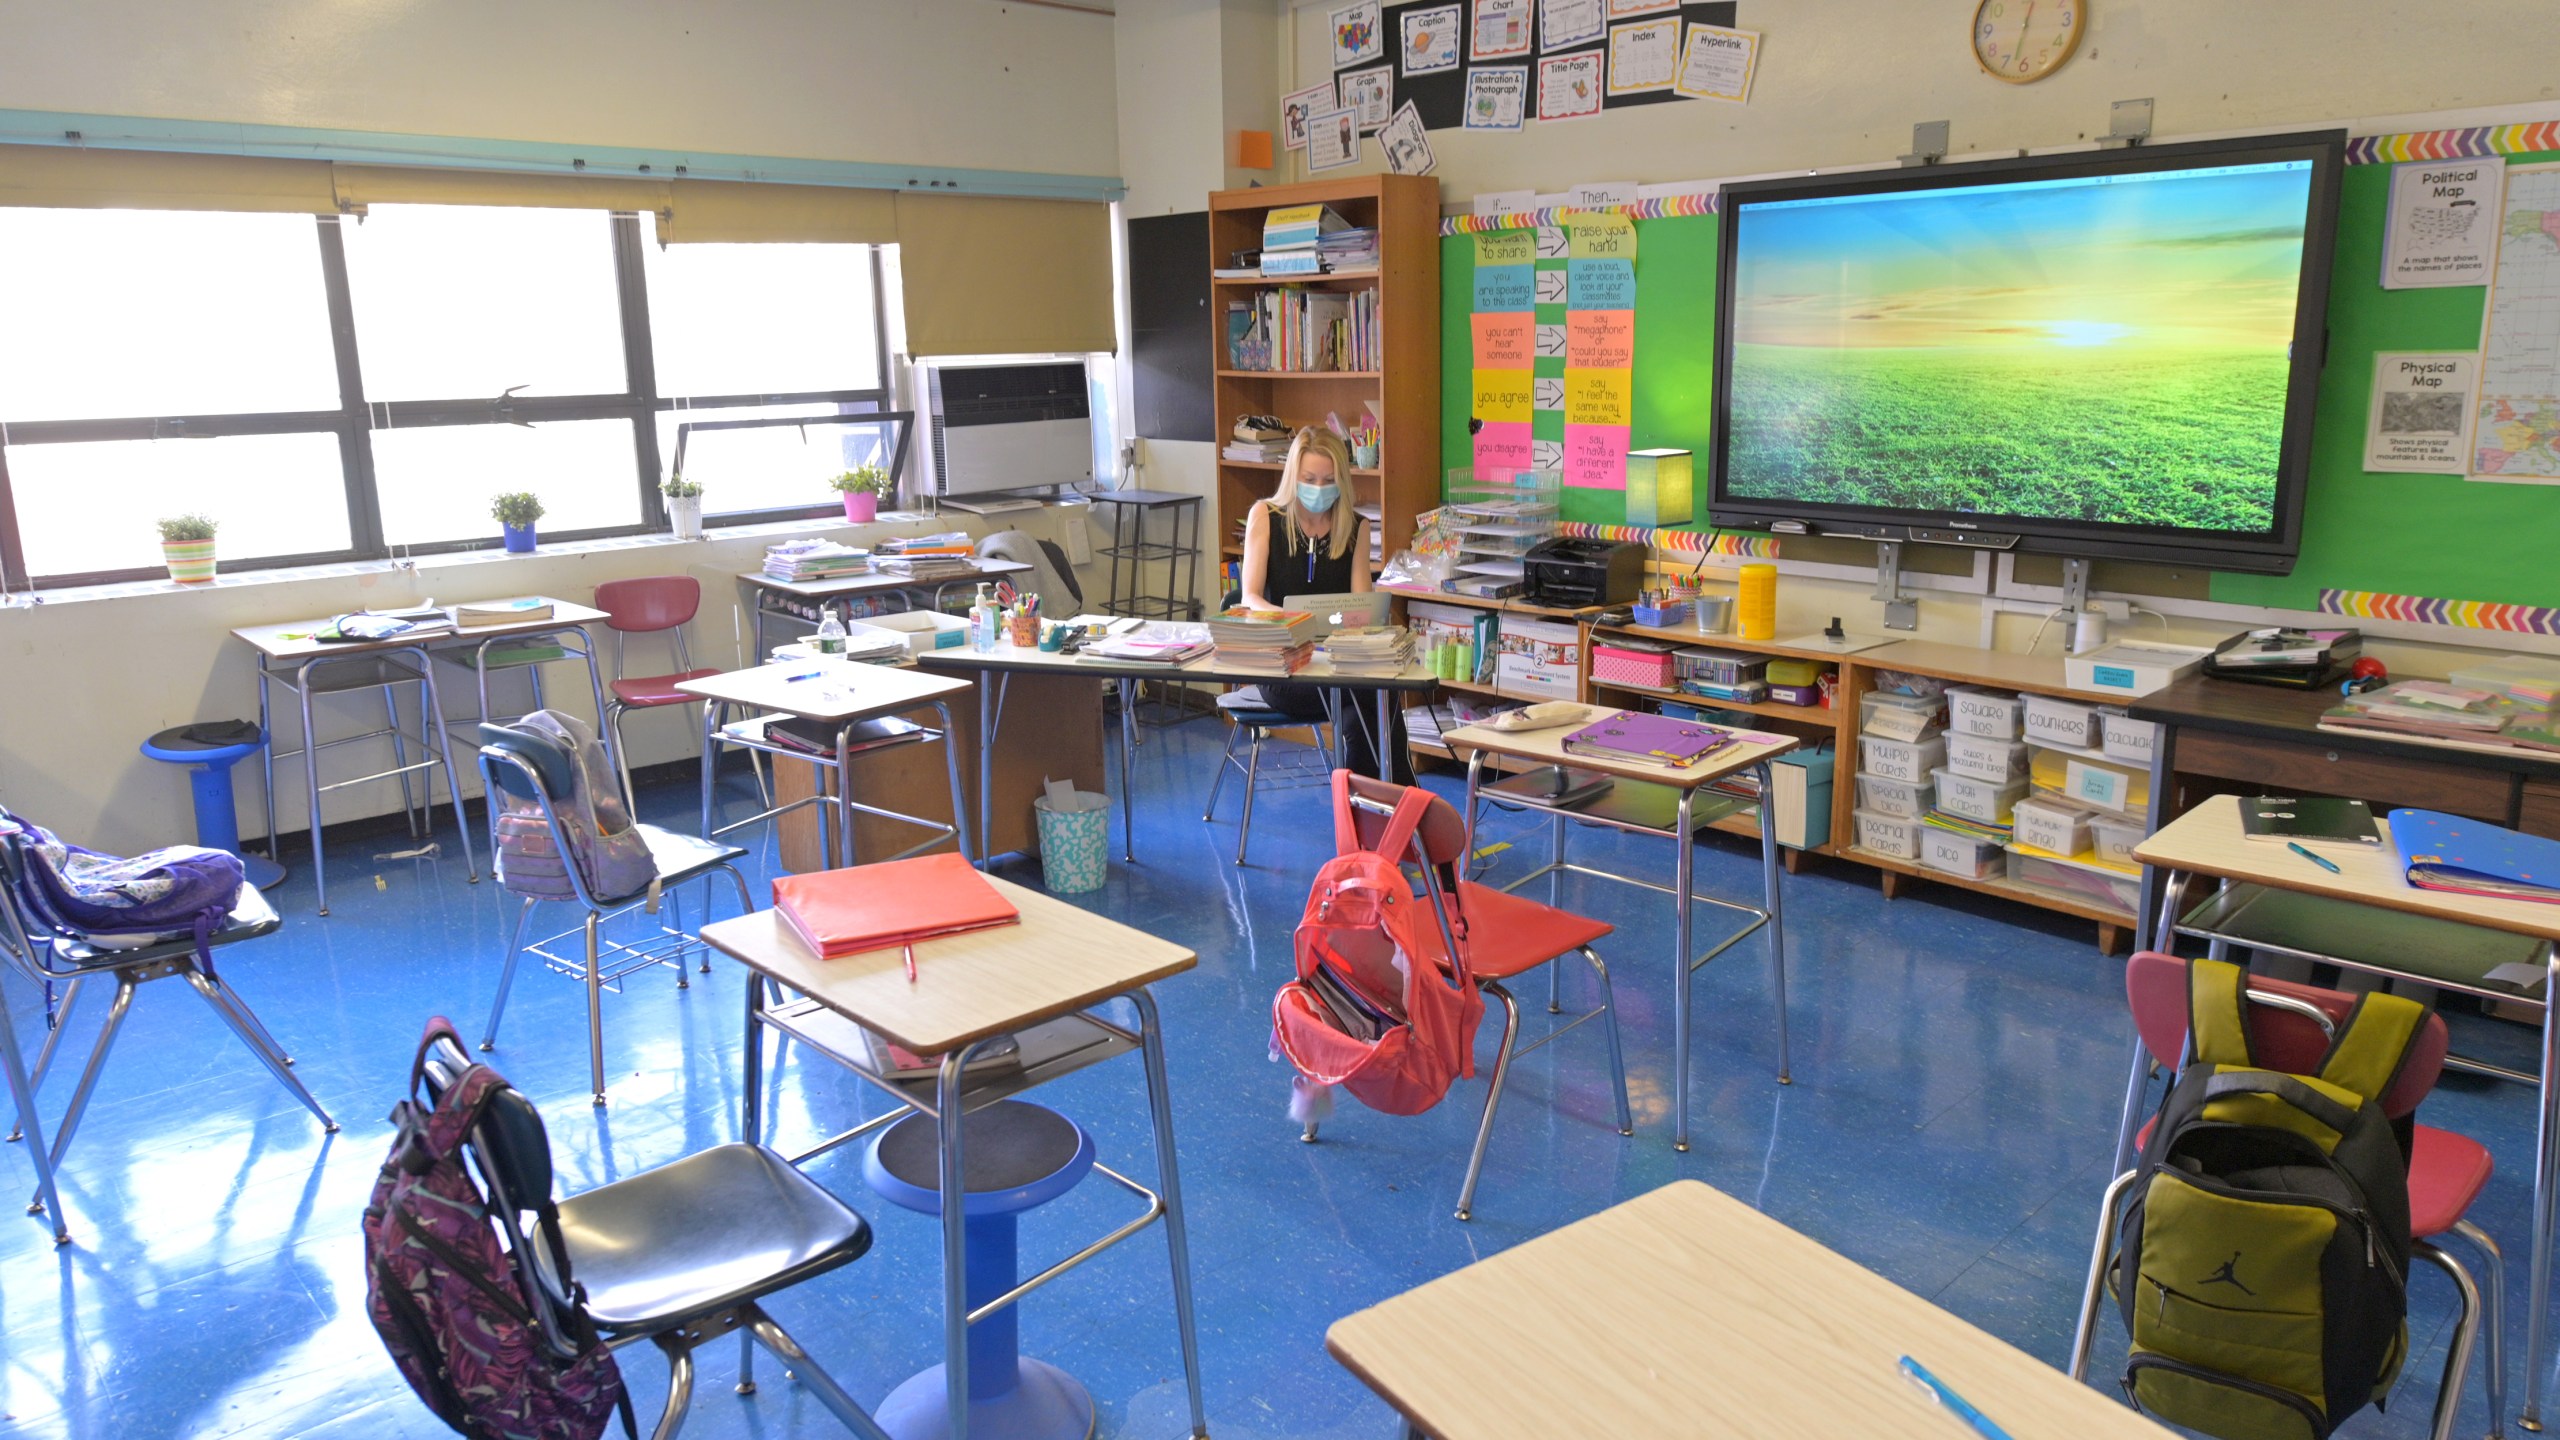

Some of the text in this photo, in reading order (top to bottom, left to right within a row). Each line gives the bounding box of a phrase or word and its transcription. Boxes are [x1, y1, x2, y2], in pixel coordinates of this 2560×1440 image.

[1493, 0, 1514, 11] Chart
[1990, 3, 2003, 19] 10
[1349, 11, 1363, 22] Map
[1419, 17, 1446, 28] Caption
[2062, 11, 2072, 27] 3
[1983, 23, 1993, 39] 9
[1632, 32, 1656, 43] Index
[1701, 35, 1742, 50] Hyperlink
[2052, 33, 2064, 47] 4
[1987, 42, 1997, 58] 8
[2001, 54, 2012, 69] 7
[2038, 49, 2049, 65] 5
[1551, 61, 1589, 74] Title Page
[2019, 57, 2029, 73] 6
[1357, 76, 1377, 88] Graph
[1475, 74, 1514, 84] Illustration
[1475, 85, 1518, 96] Photograph
[1408, 120, 1425, 158] Diagram
[2422, 169, 2478, 185] Political
[1581, 191, 1621, 204] Then...
[2433, 186, 2465, 198] Map
[1493, 199, 1511, 212] If...
[1573, 225, 1631, 241] raise your
[1480, 235, 1501, 250] you
[1589, 239, 1618, 253] hand
[1482, 246, 1527, 260] to share
[2412, 257, 2431, 265] map
[2456, 263, 2482, 271] places
[1583, 264, 1596, 272] use
[1494, 274, 1511, 284] you
[1574, 272, 1630, 281] clear voice and
[1479, 285, 1530, 299] are speaking
[1580, 283, 1624, 295] look at your
[1482, 296, 1528, 306] to the class
[1582, 293, 1621, 301] classmates
[1594, 316, 1608, 325] say
[1486, 327, 1523, 342] you can't
[1495, 339, 1514, 348] hear
[1486, 352, 1523, 360] someone
[1598, 348, 1612, 360] you
[1614, 348, 1629, 361] say
[1575, 358, 1590, 367] that
[2400, 362, 2457, 375] Physical
[1591, 379, 1606, 393] say
[2412, 376, 2443, 389] Map
[1586, 390, 1603, 400] feel
[1605, 390, 1618, 400] the
[1477, 394, 1530, 409] you agree
[1576, 403, 1599, 412] same
[1589, 436, 1604, 449] say
[2417, 439, 2449, 447] physical
[1478, 443, 1528, 458] you disagree
[1587, 446, 1606, 457] have
[1609, 449, 1615, 457] a
[2376, 453, 2418, 461] mountains
[1577, 459, 1615, 469] different
[1949, 522, 1978, 530] Promethean
[1537, 658, 1543, 667] 2
[1509, 665, 1571, 681] Benchmark Assessment System
[1988, 754, 1993, 762] &
